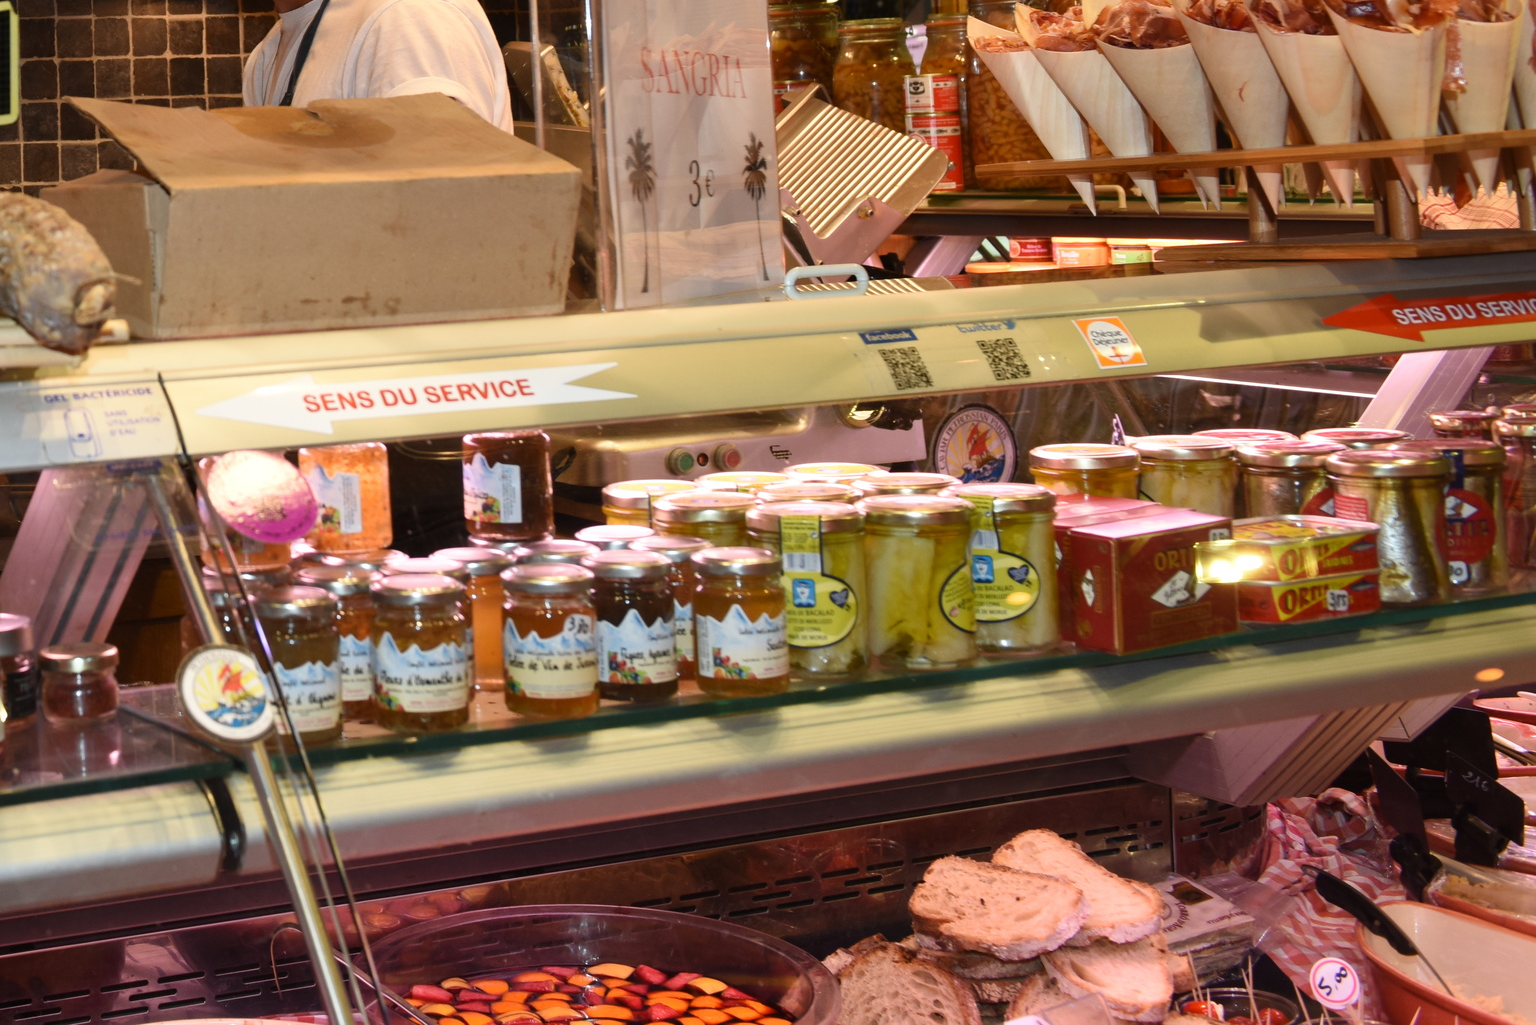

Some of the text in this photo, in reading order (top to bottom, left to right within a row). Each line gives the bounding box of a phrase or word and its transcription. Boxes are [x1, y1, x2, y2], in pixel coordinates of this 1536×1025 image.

[640, 46, 748, 100] SANGRIA
[688, 159, 716, 208] 3 €
[1391, 306, 1447, 325] SENS
[1444, 303, 1477, 321] DU
[957, 321, 1005, 334] twitter
[865, 331, 913, 343] facebook
[1090, 328, 1123, 342] Chèque
[1094, 336, 1130, 348] Déjeuner
[43, 393, 68, 405] GEL
[301, 376, 538, 415] SENS DU SERVICE
